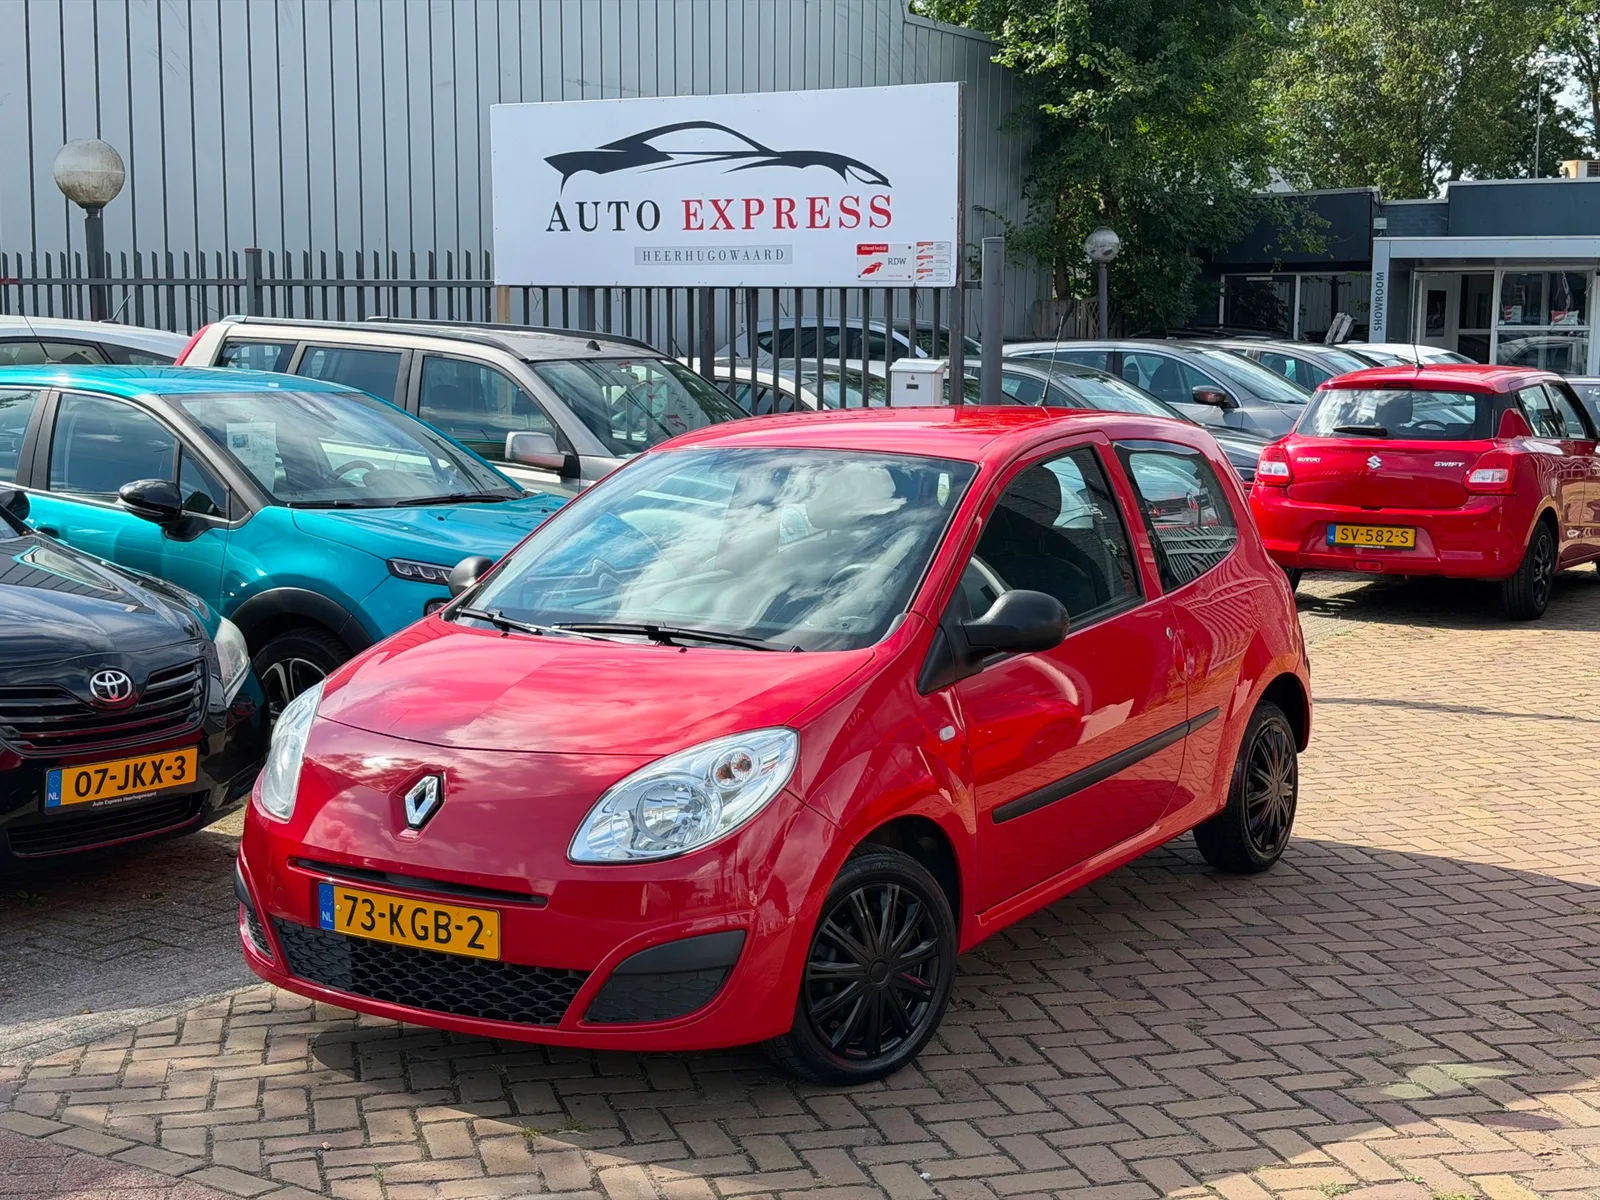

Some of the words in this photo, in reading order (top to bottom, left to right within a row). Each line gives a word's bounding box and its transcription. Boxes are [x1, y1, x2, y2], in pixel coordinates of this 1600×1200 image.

[545, 200, 661, 232] AUTO
[682, 195, 893, 231] EXPRESS
[642, 249, 784, 262] HEERHUGOWAARD
[887, 257, 906, 265] RDW
[1374, 271, 1385, 331] SHOWROOM
[1433, 460, 1465, 468] SWIFT
[1340, 527, 1409, 544] SV-582-S
[74, 755, 186, 797] 07-JKX-3
[48, 792, 59, 801] NL
[321, 910, 333, 923] NL
[343, 894, 485, 950] 73-KGB-2
